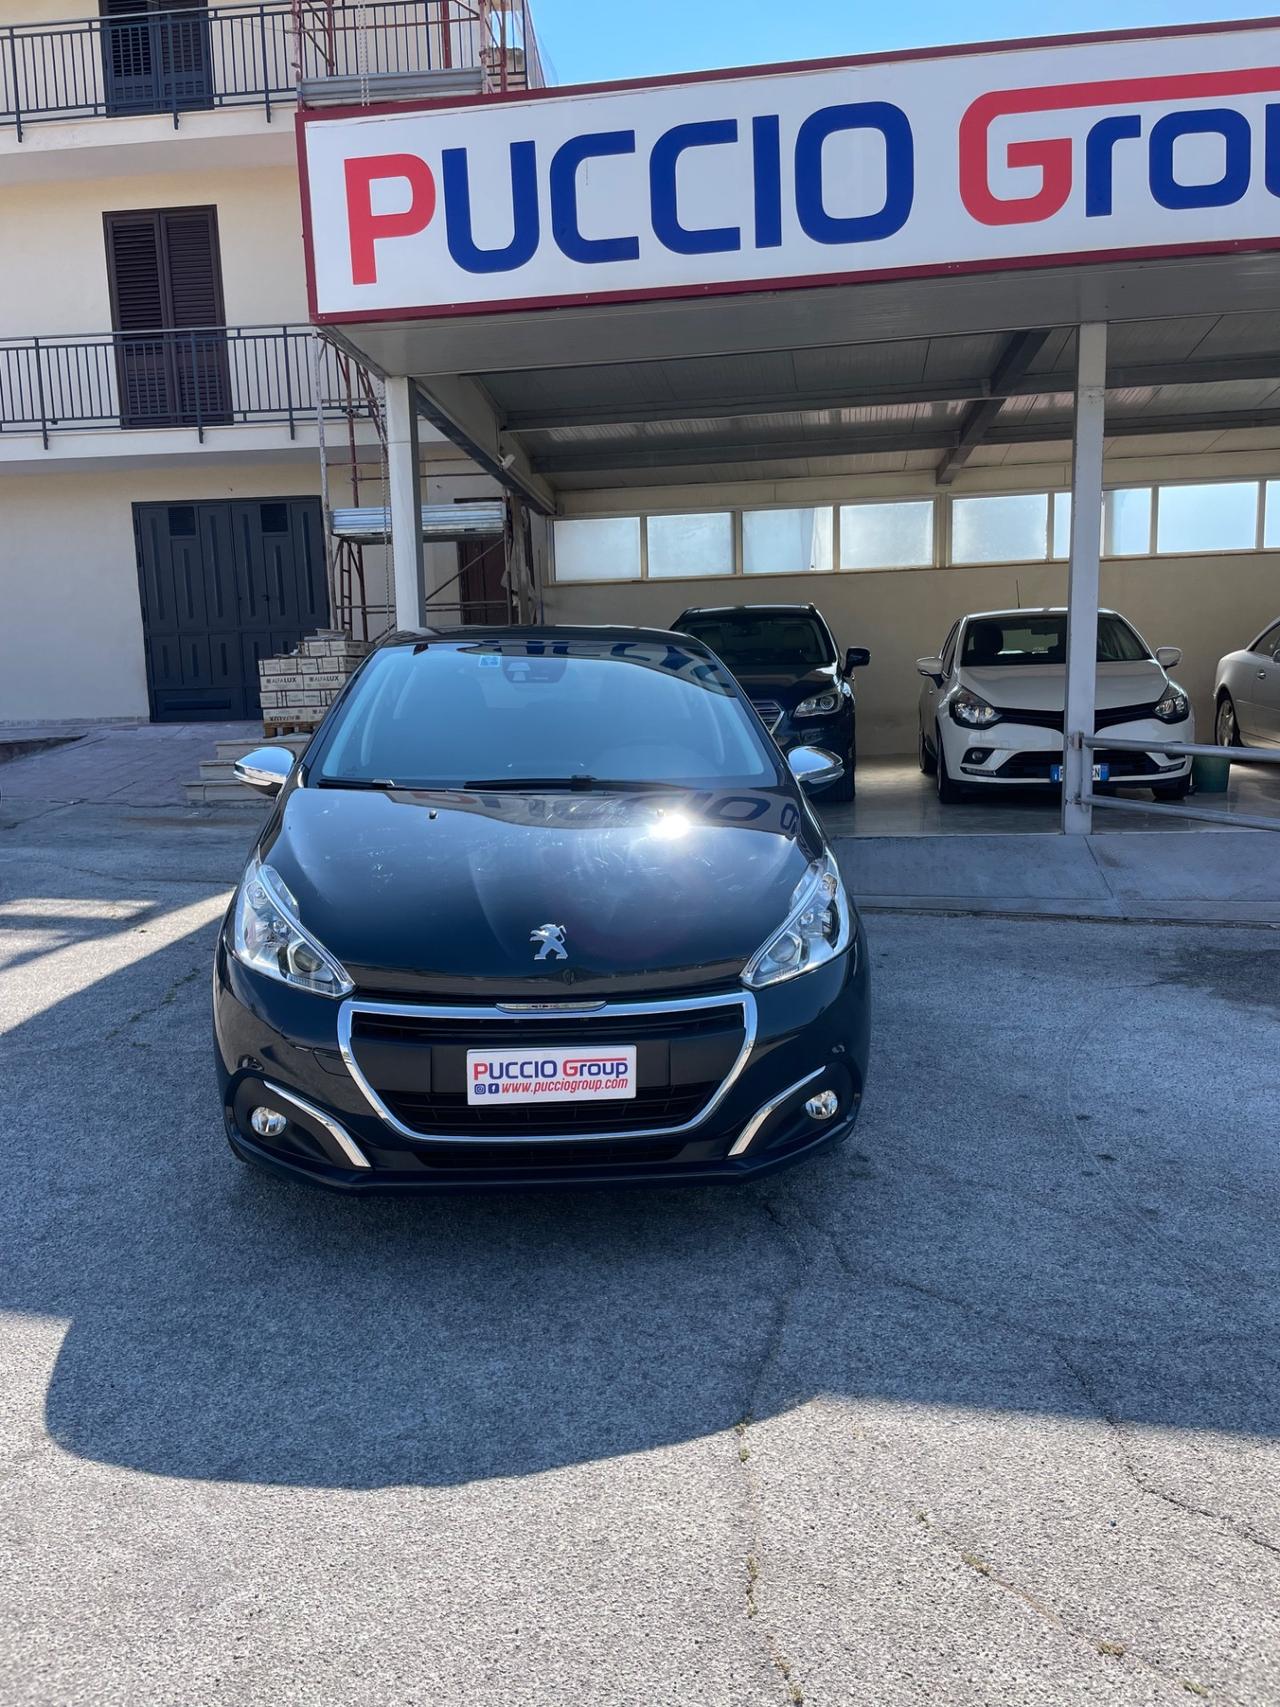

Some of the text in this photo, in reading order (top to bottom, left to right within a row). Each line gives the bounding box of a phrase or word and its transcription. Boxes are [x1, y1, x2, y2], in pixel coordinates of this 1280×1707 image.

[344, 66, 1280, 285] PUCCIO Gro
[271, 676, 297, 684] ALFALUX
[473, 1057, 629, 1080] PUCCIO Group
[501, 1078, 628, 1095] www.pucciogroup.com
